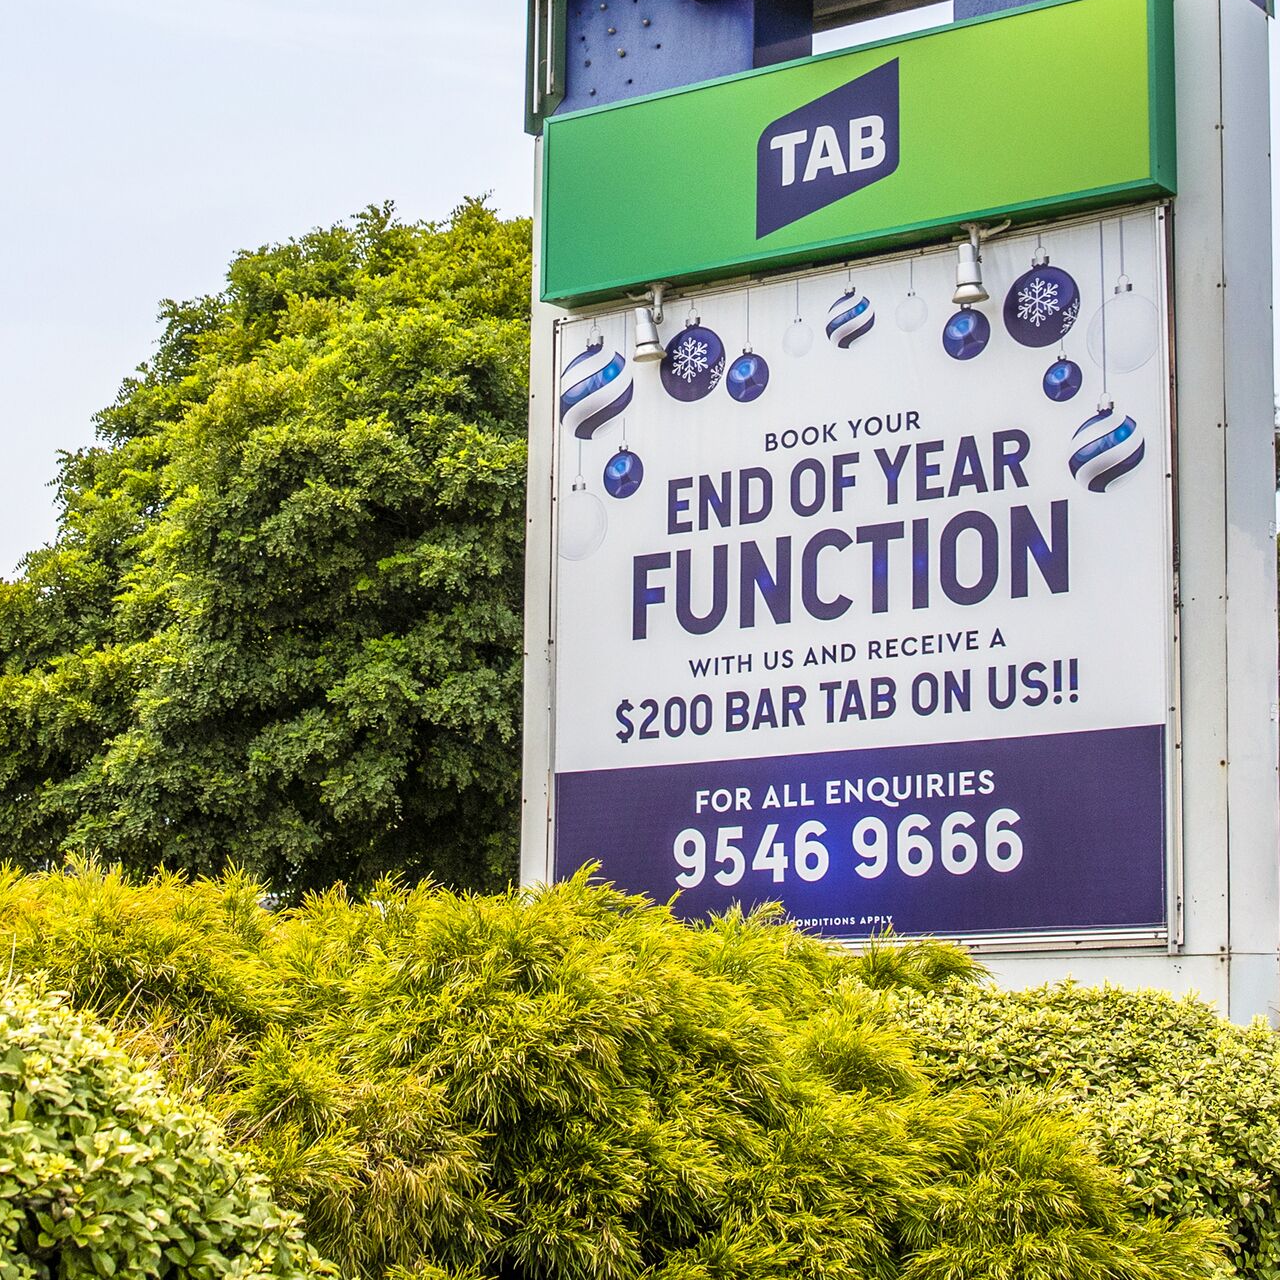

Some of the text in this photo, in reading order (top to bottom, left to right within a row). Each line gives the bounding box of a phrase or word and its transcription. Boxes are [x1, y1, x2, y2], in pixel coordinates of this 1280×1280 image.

[769, 114, 887, 187] TAB
[765, 410, 921, 452] BOOK YOUR
[667, 428, 1031, 536] END OF YEAR
[632, 498, 1070, 641] FUNCTION
[688, 627, 1007, 678] WITH US AND RECEIVE A
[615, 657, 1079, 744] $200 BAR TAB ON US!!
[695, 769, 995, 814] FOR ALL ENQUIRIES
[673, 808, 1024, 889] 9546 9666
[860, 915, 893, 925] APPLY
